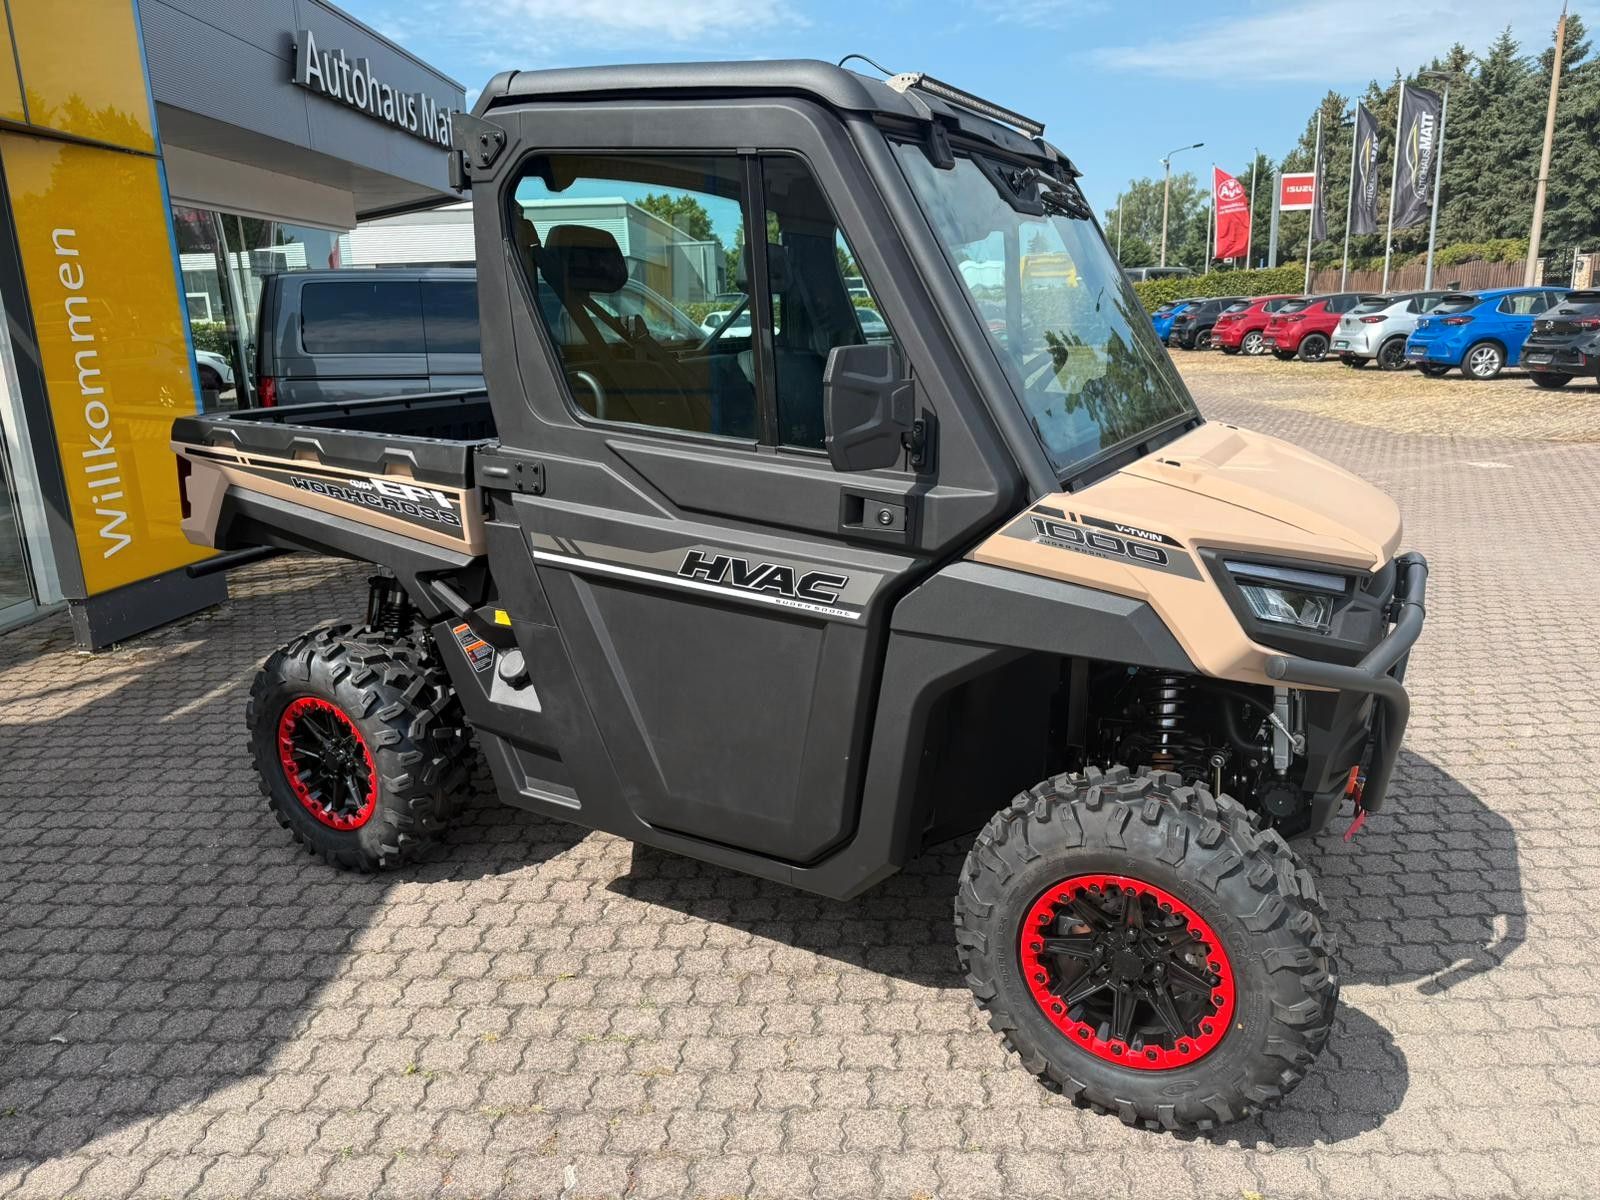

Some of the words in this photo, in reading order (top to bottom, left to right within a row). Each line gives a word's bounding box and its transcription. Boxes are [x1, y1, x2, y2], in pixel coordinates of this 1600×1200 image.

[304, 30, 418, 132] Autohaus
[1286, 185, 1314, 193] ISUZU
[52, 228, 132, 559] Willkommen
[291, 476, 462, 527] WORKCROSS
[1030, 516, 1169, 567] 1000
[1115, 524, 1163, 542] V-TWIN
[677, 549, 849, 604] HVAC
